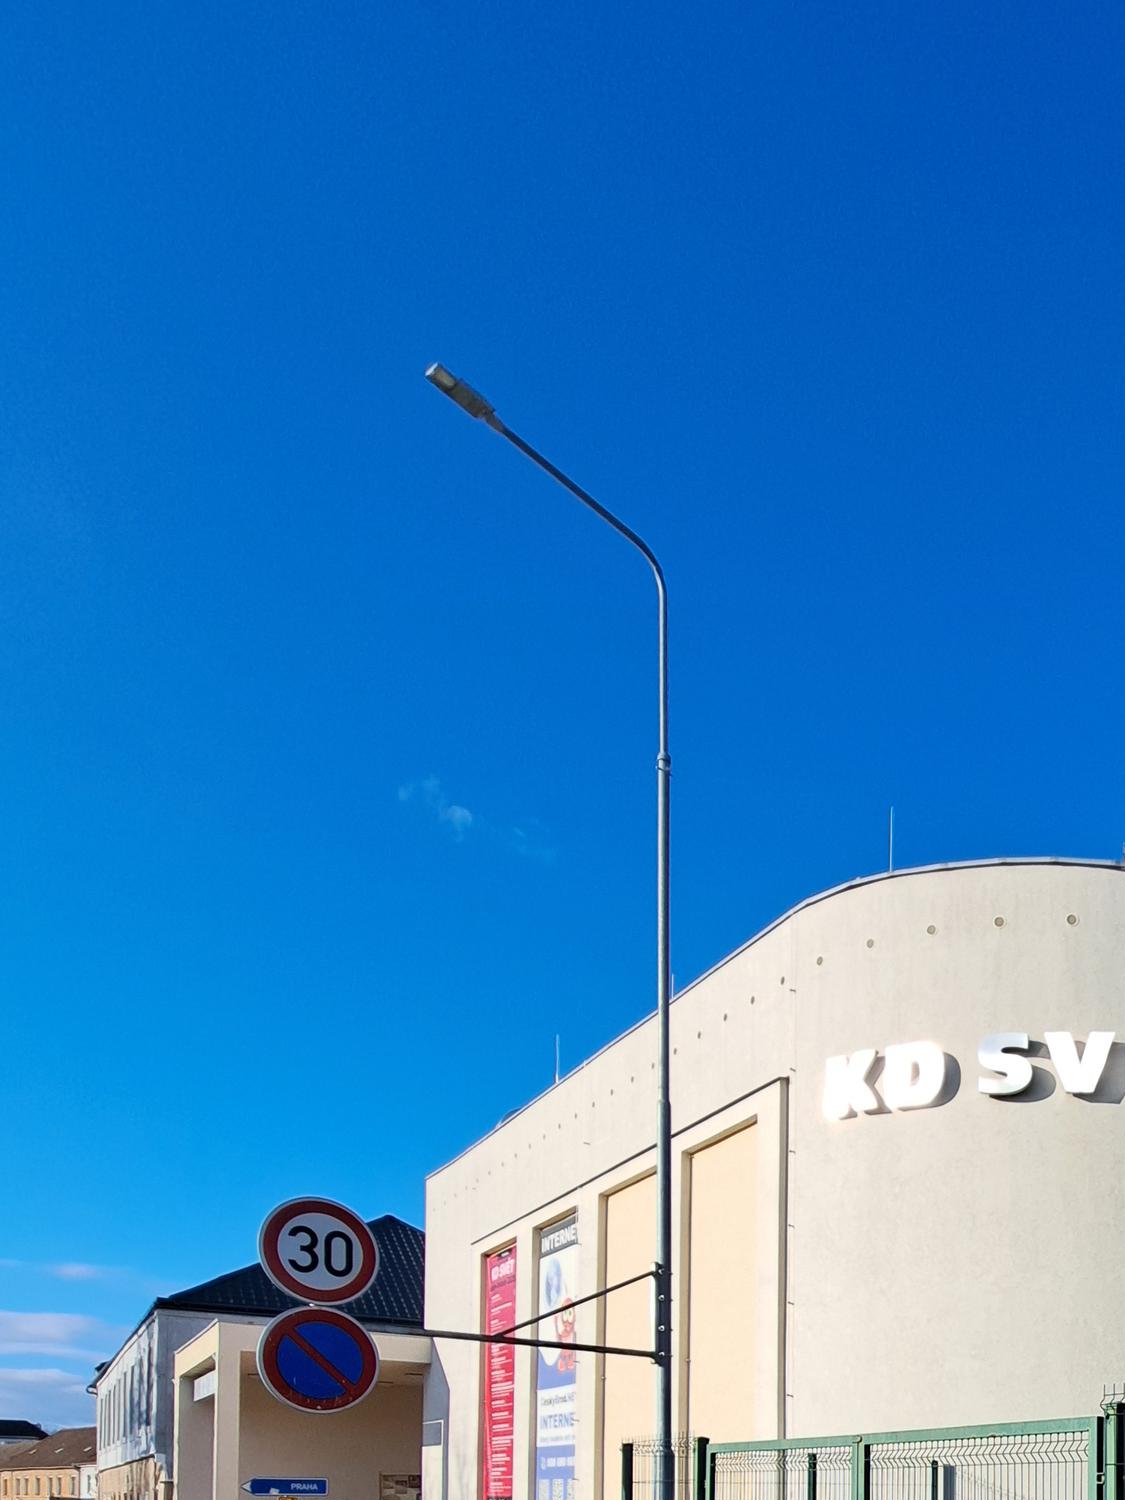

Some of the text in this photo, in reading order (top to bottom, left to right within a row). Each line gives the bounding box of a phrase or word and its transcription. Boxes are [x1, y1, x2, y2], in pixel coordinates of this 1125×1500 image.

[822, 1040, 945, 1120] KD
[288, 1225, 353, 1278] 30
[541, 1411, 576, 1430] INTERNE
[290, 1482, 319, 1491] PRAHA
